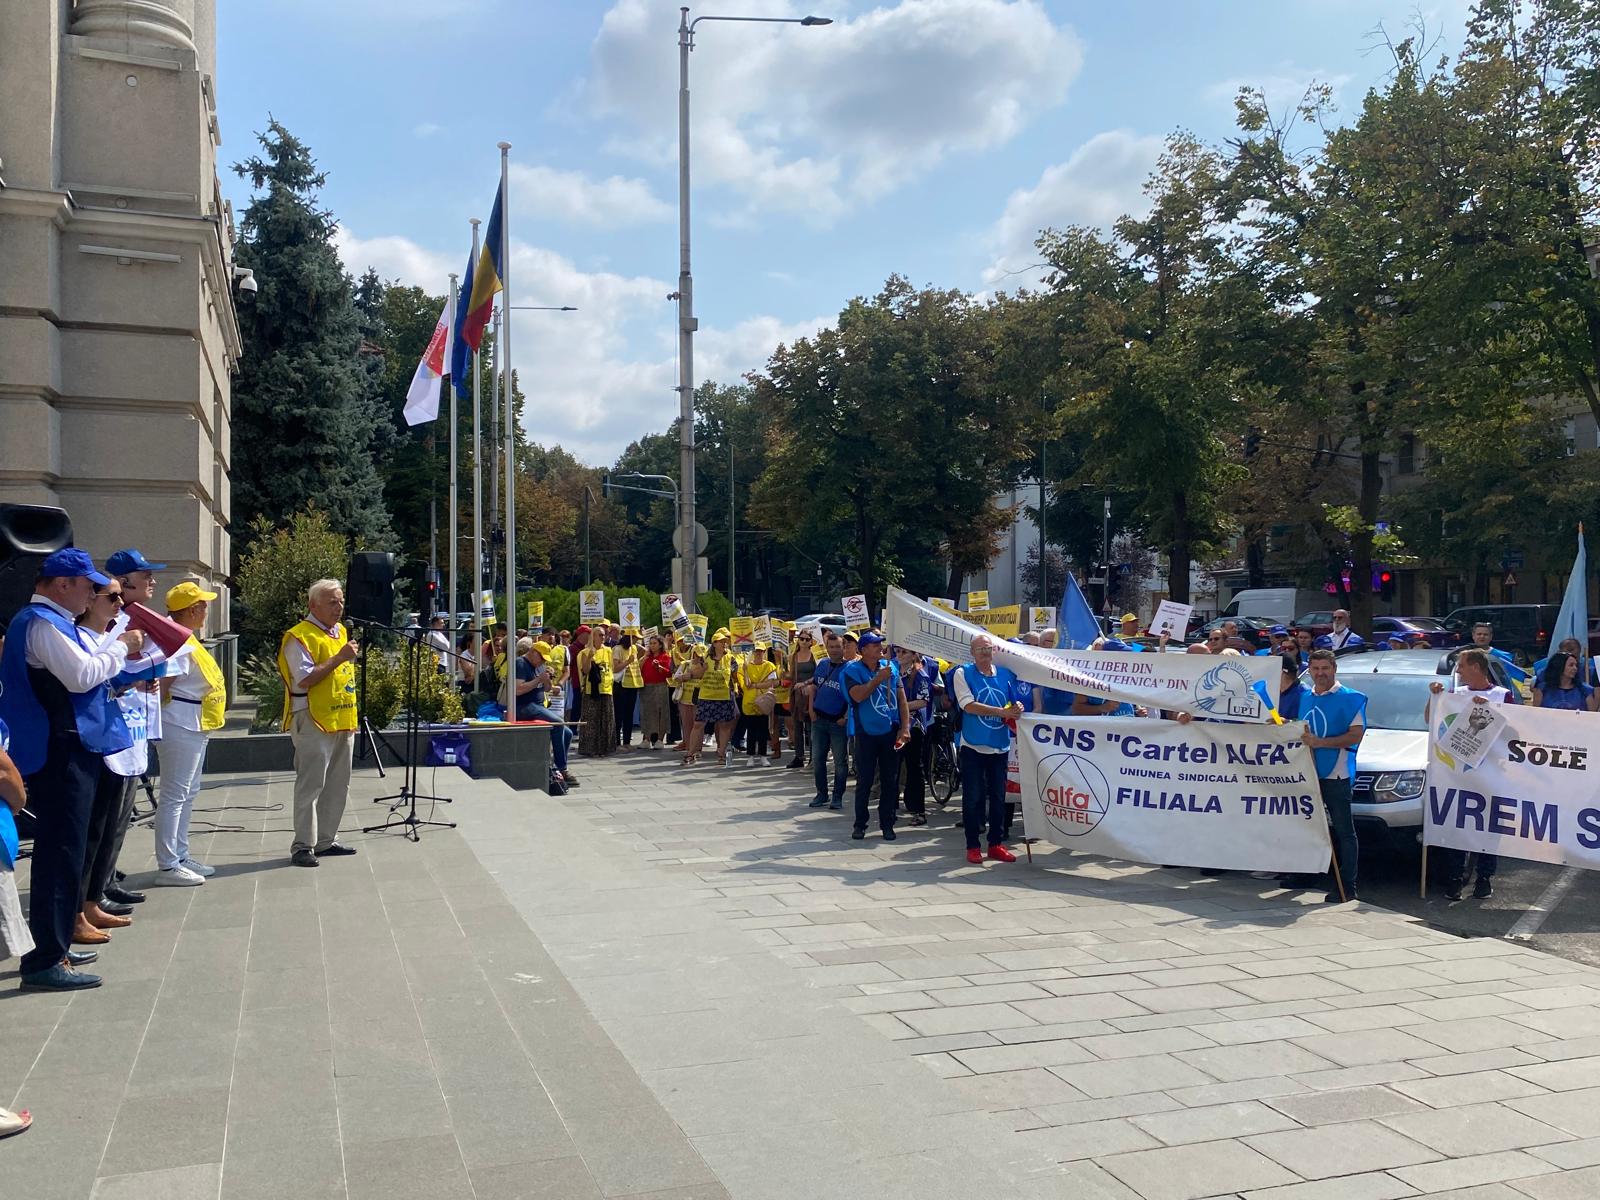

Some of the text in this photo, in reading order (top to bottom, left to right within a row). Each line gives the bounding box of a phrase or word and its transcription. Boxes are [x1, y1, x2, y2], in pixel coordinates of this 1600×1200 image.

[1094, 660, 1127, 674] LIBER
[1131, 662, 1154, 674] DIN
[1166, 679, 1189, 691] DIN
[1032, 723, 1303, 766] CNS "Cartel ALFA"
[1507, 739, 1587, 771] SOLE
[1120, 767, 1306, 785] UNIUNEA SINDICALĂ TERITORIALĂ
[1046, 786, 1090, 810] alfa
[1116, 787, 1223, 814] FILIALA
[1045, 804, 1094, 826] CARTEL
[1429, 786, 1559, 844] VREM
